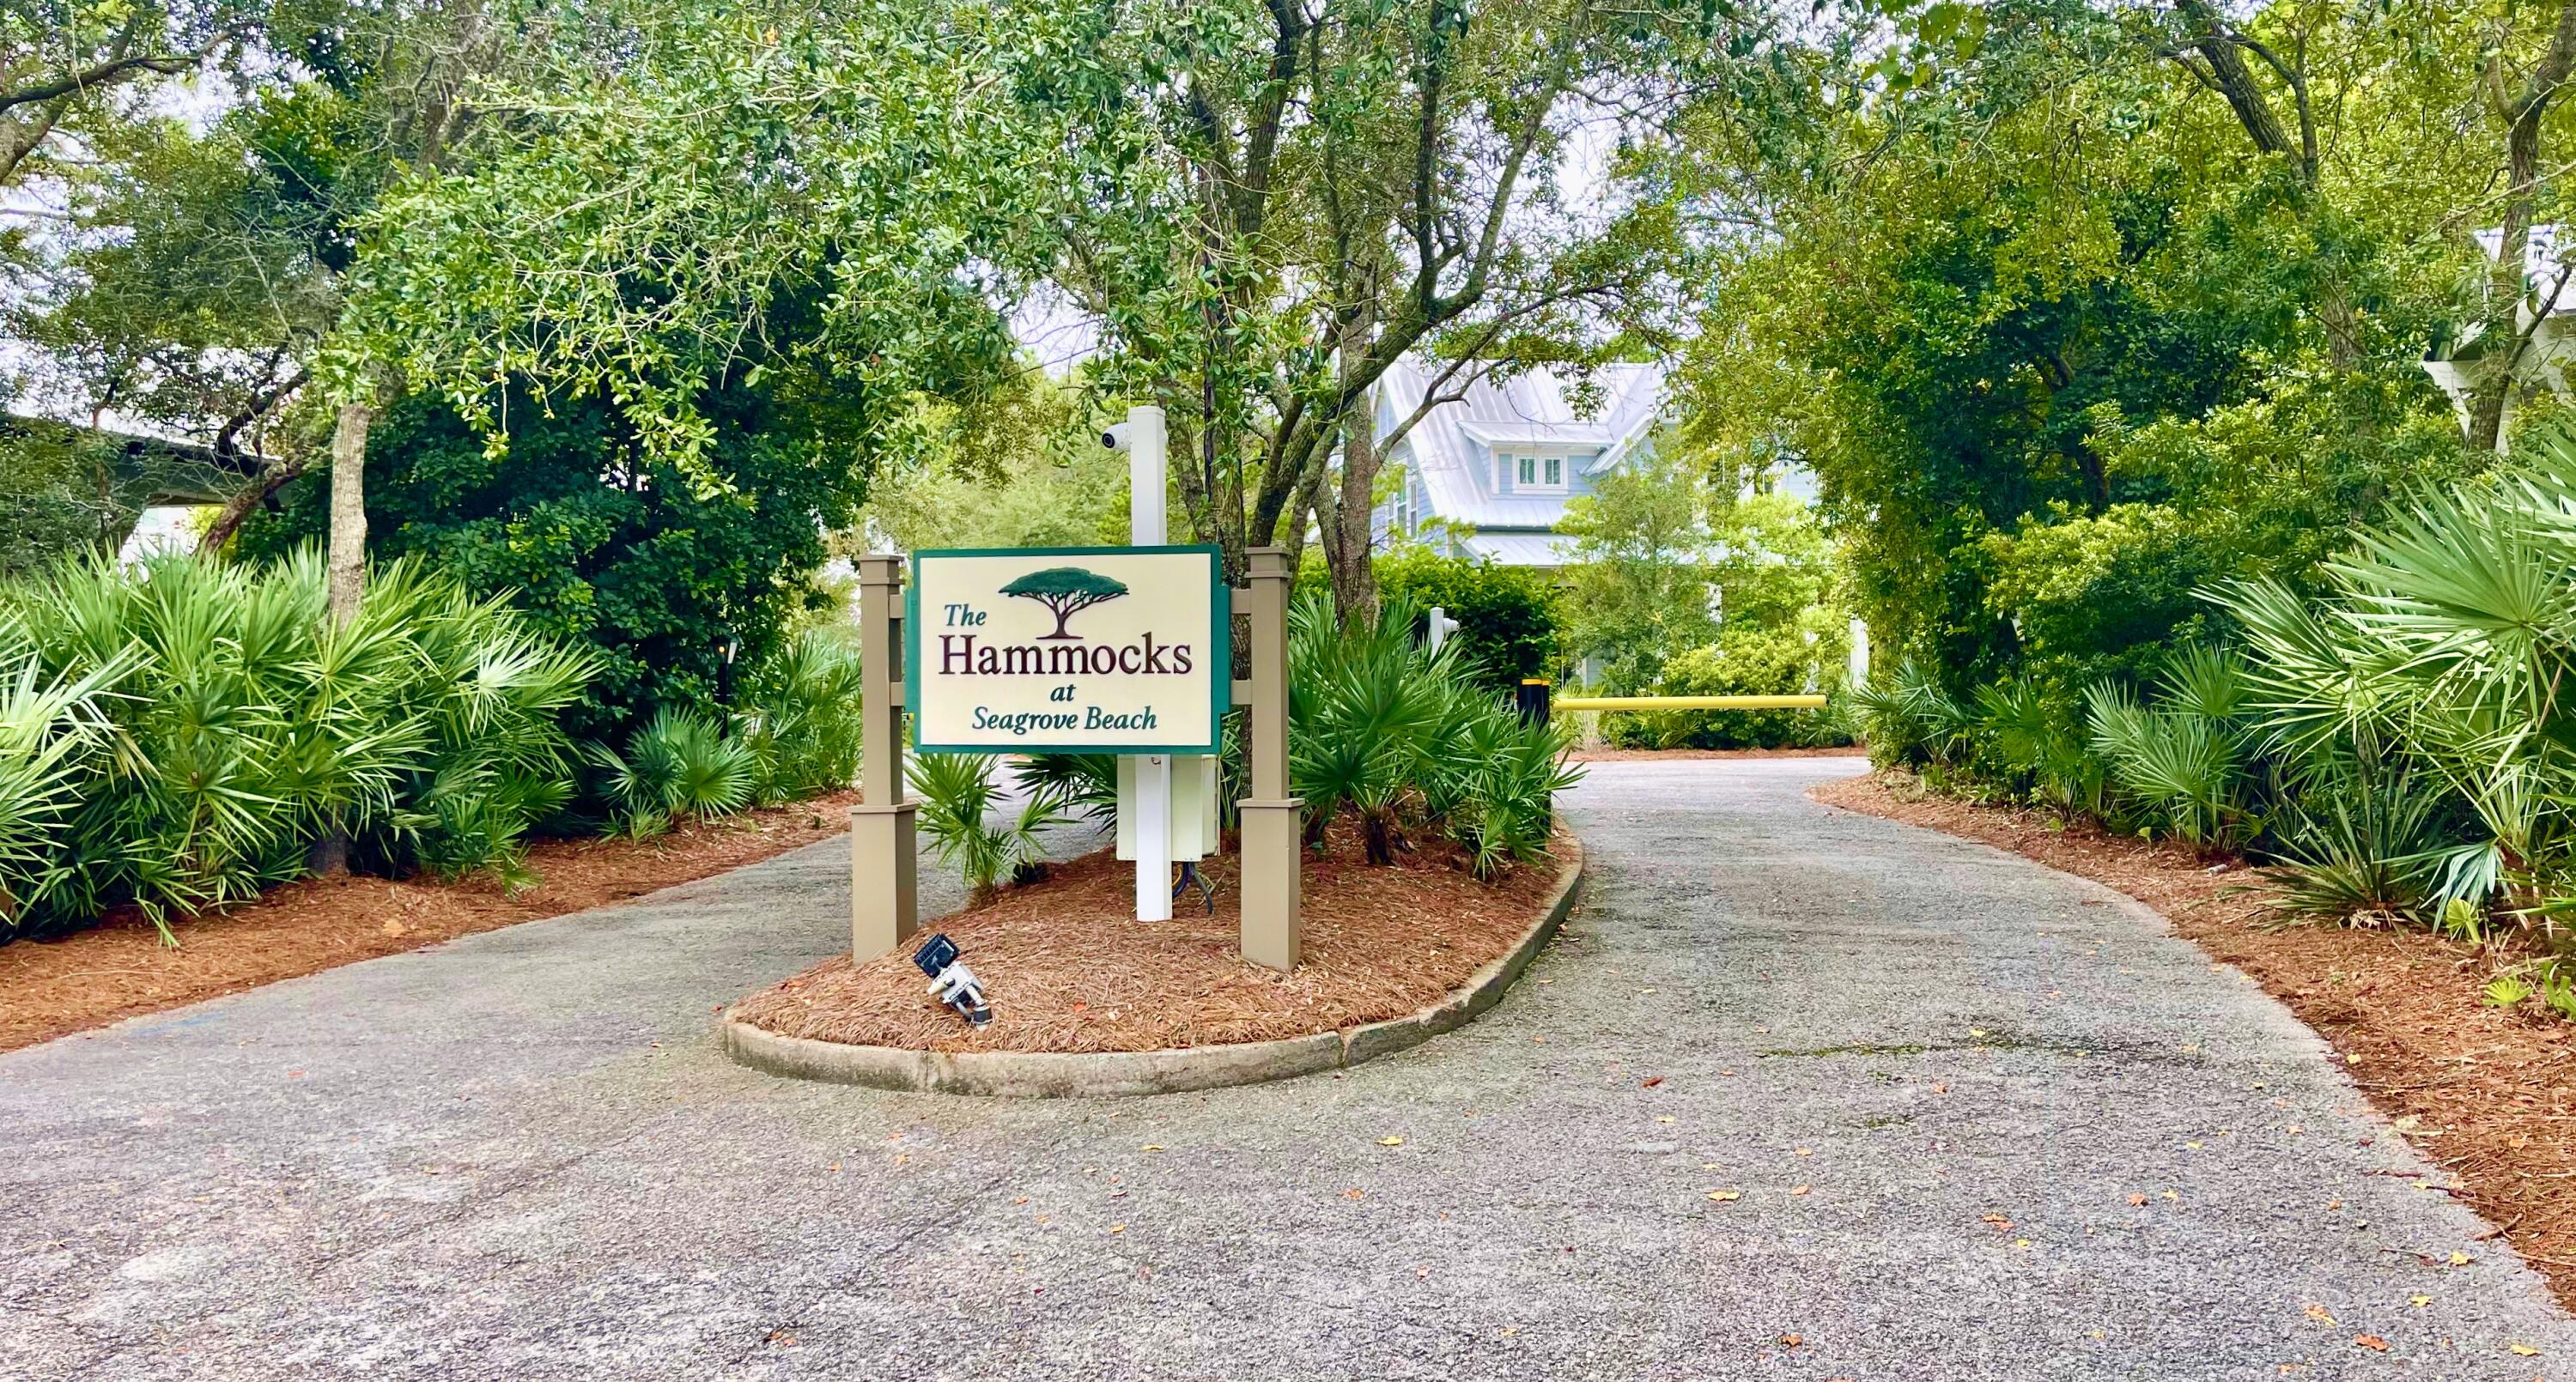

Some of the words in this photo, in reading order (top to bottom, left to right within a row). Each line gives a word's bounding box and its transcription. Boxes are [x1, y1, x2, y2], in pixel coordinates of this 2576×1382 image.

[945, 603, 987, 627] The
[939, 632, 1193, 675] Hammocks
[1050, 684, 1076, 702] at
[972, 706, 1078, 735] Seagrove
[1084, 706, 1157, 730] Beach
